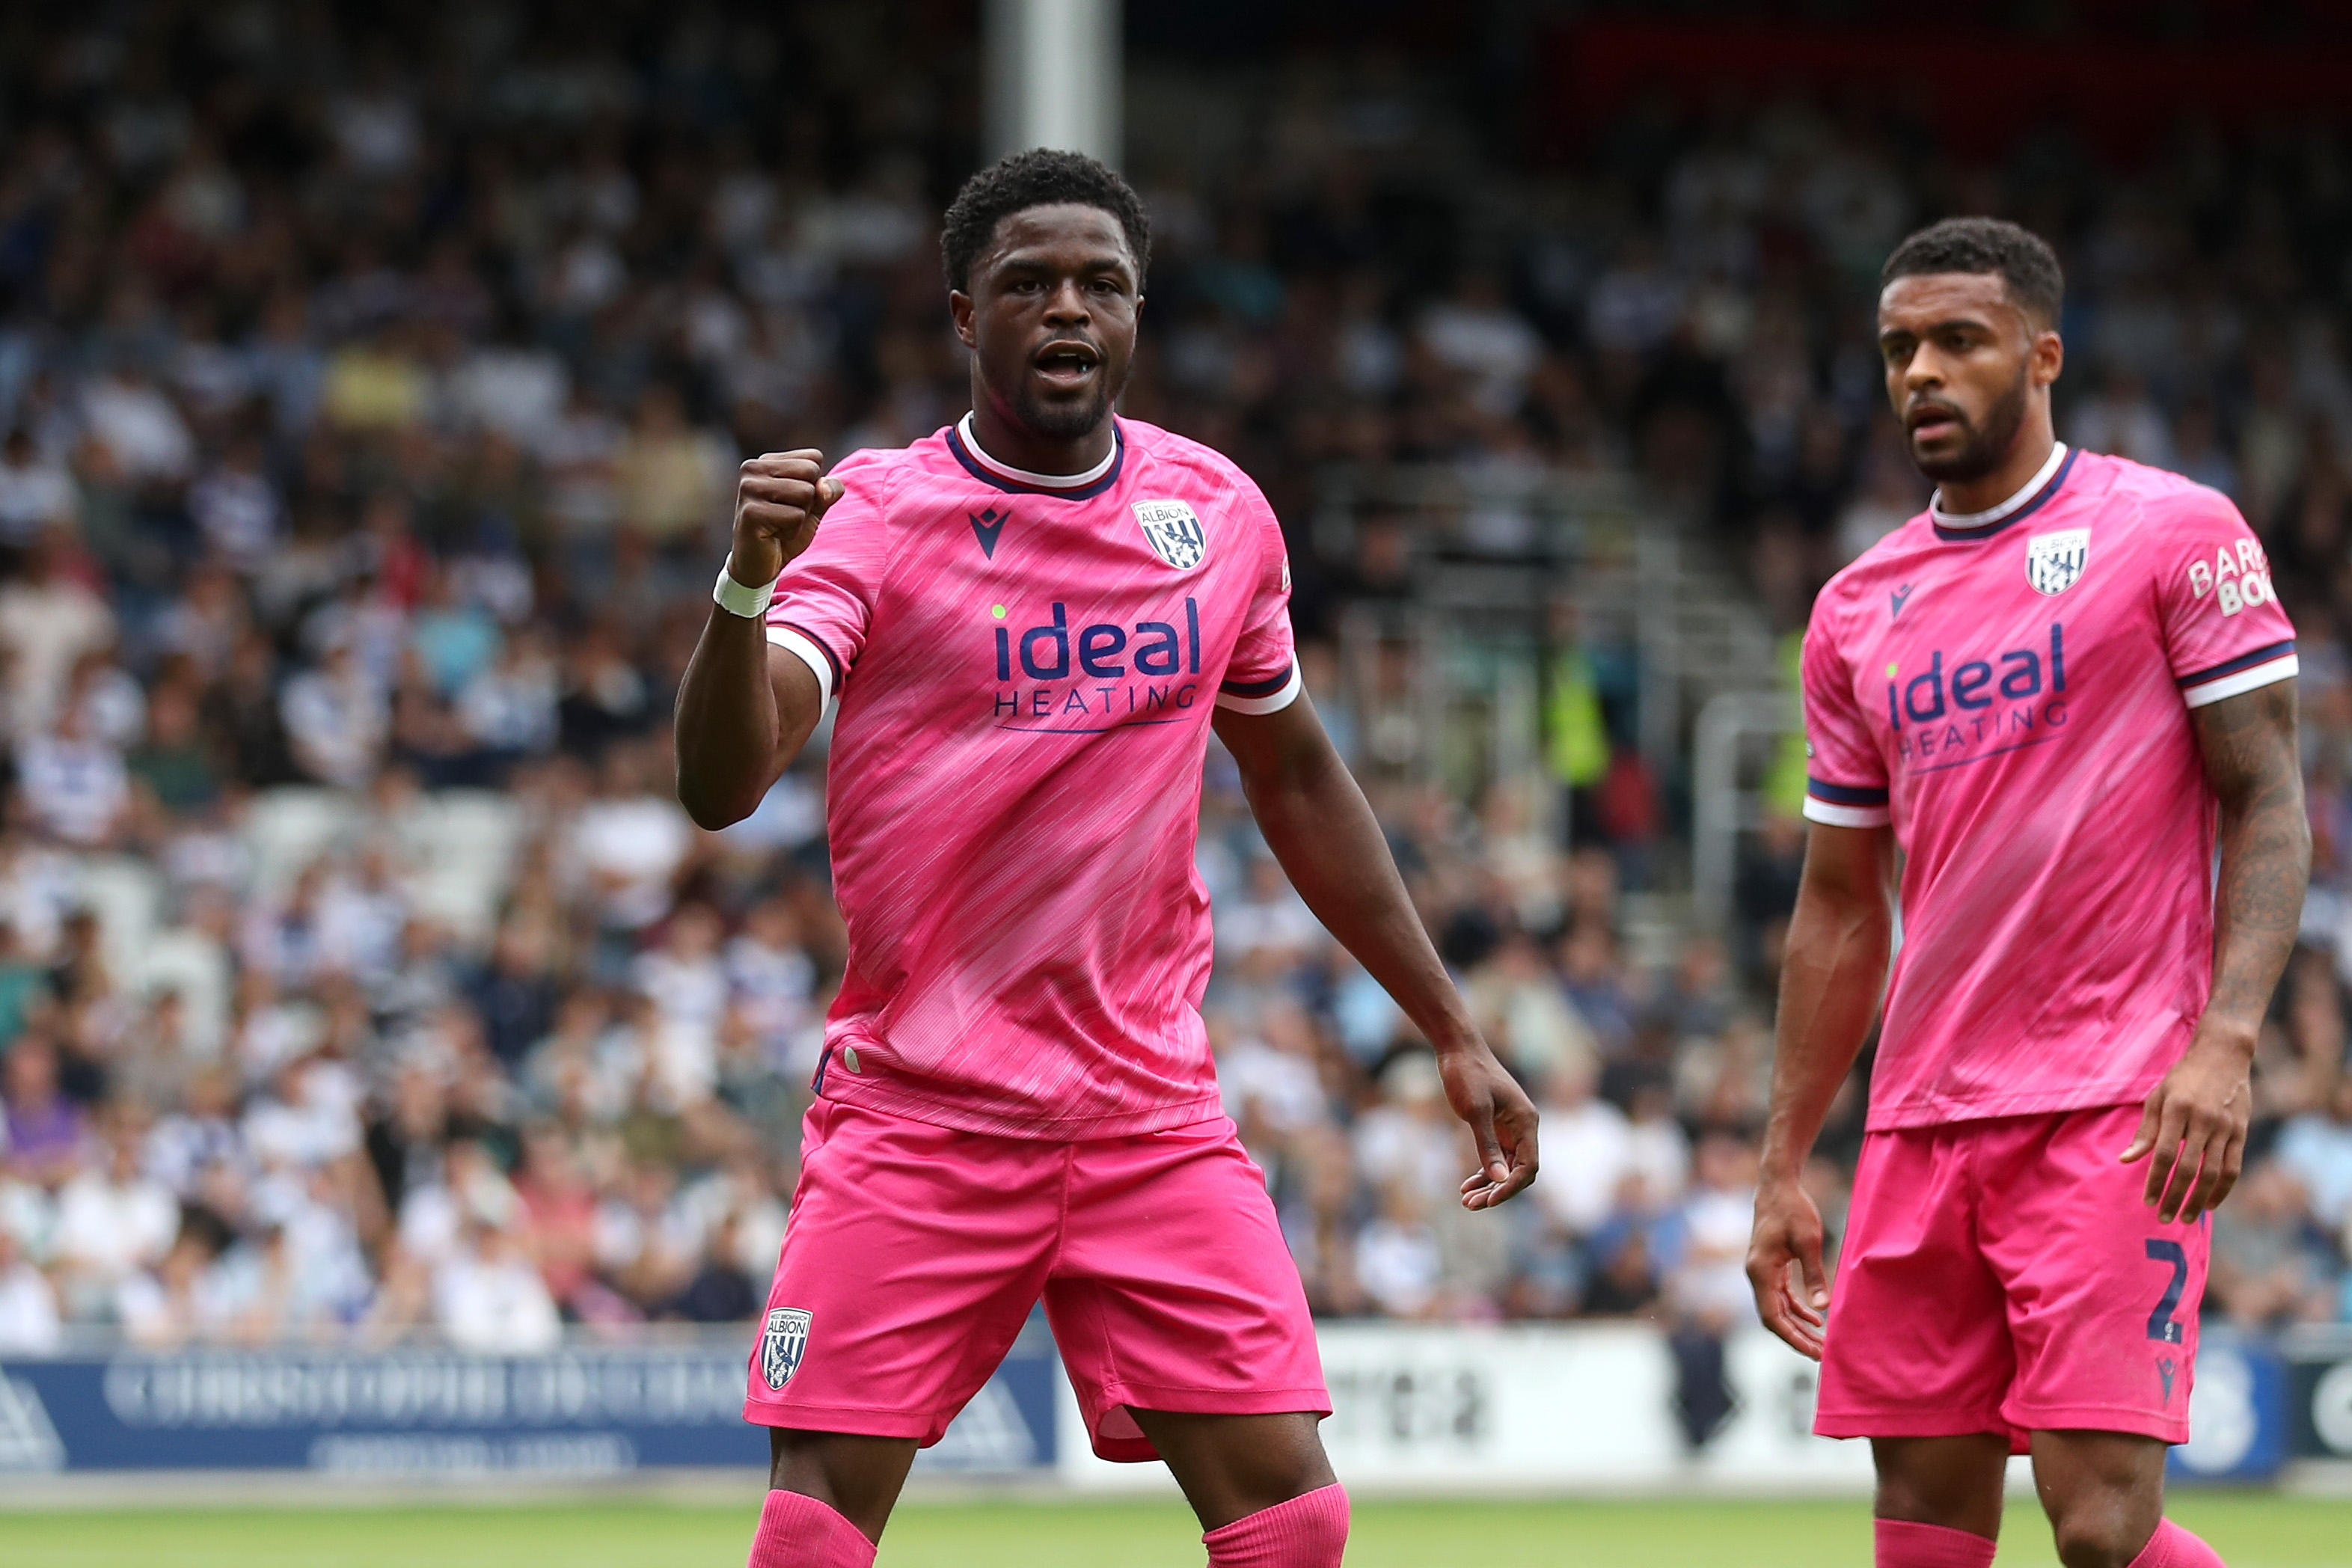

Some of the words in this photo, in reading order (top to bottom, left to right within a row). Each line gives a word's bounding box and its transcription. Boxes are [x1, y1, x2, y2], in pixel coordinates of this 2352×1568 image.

[1142, 506, 1189, 523] ALBION
[991, 597, 1200, 681] ideal
[994, 684, 1196, 717] HEATING
[1886, 624, 2065, 731] ideal
[1898, 700, 2067, 762] HEATING
[2146, 1238, 2188, 1344] 2
[767, 1320, 806, 1334] ALBION
